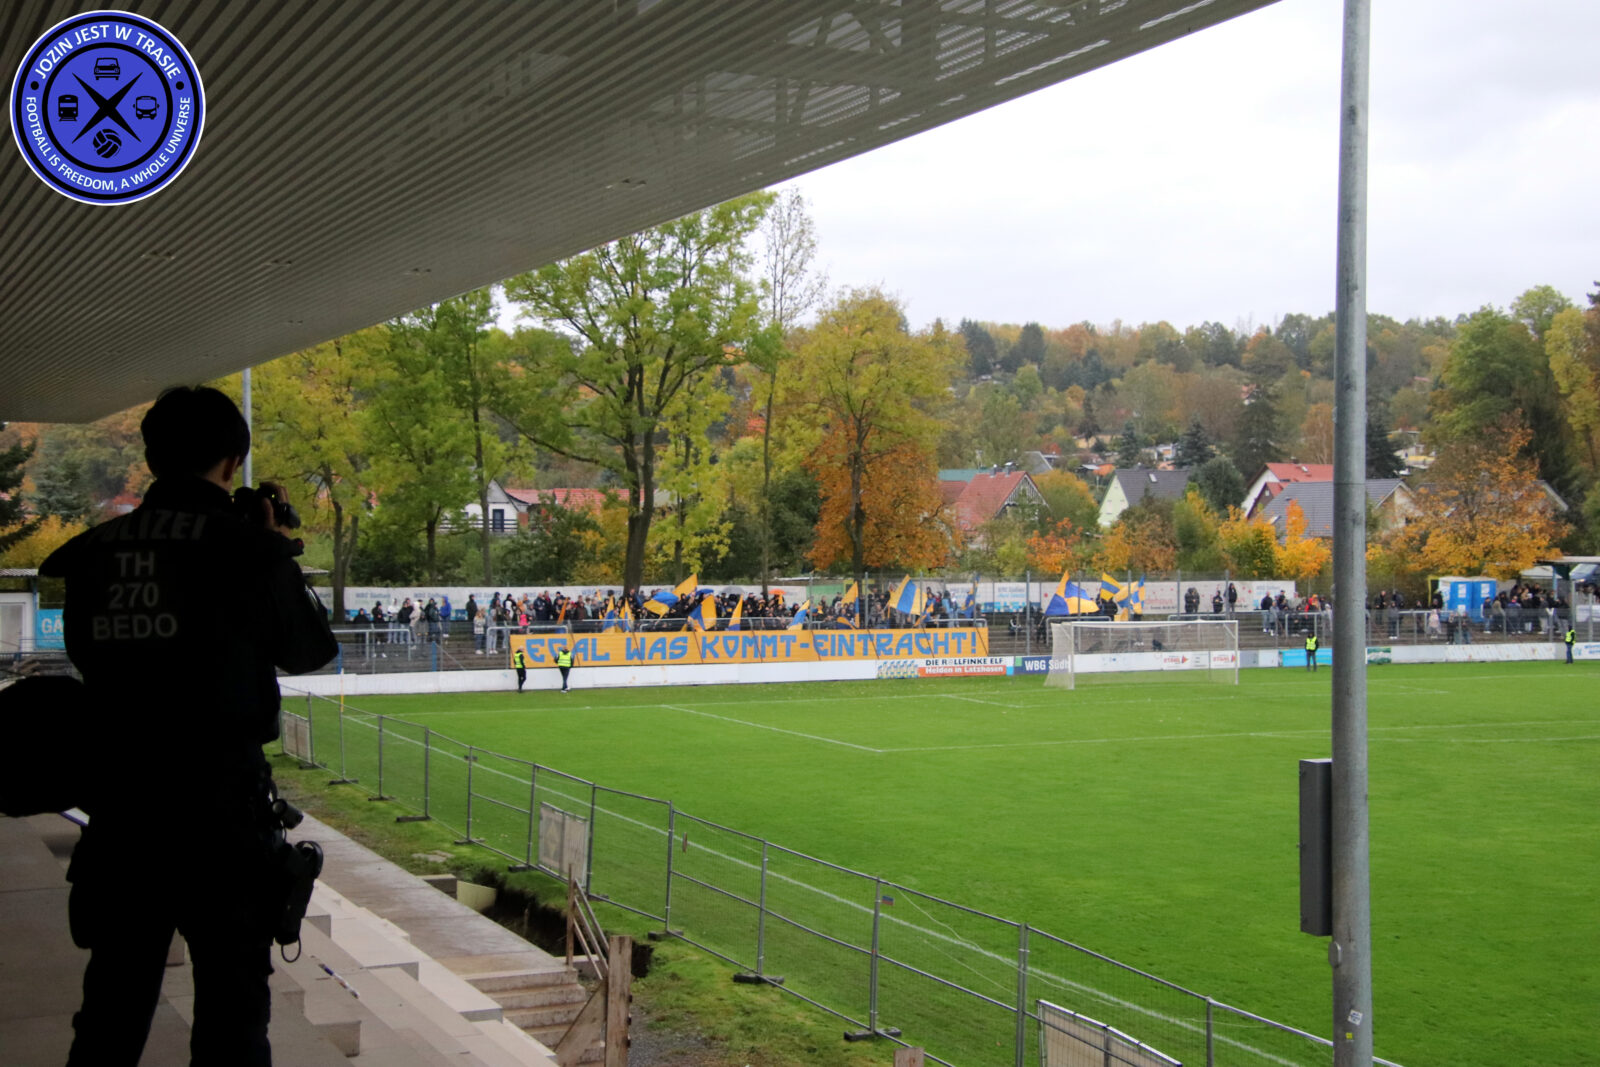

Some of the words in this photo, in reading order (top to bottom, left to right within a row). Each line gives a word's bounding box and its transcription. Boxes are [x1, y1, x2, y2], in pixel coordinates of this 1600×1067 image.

[114, 551, 155, 577] TH
[108, 582, 159, 609] 270
[92, 612, 178, 640] BEDO
[525, 638, 610, 663] EGAL
[625, 636, 688, 661] WAS
[990, 657, 1004, 665] ELF
[1024, 660, 1047, 671] WBG
